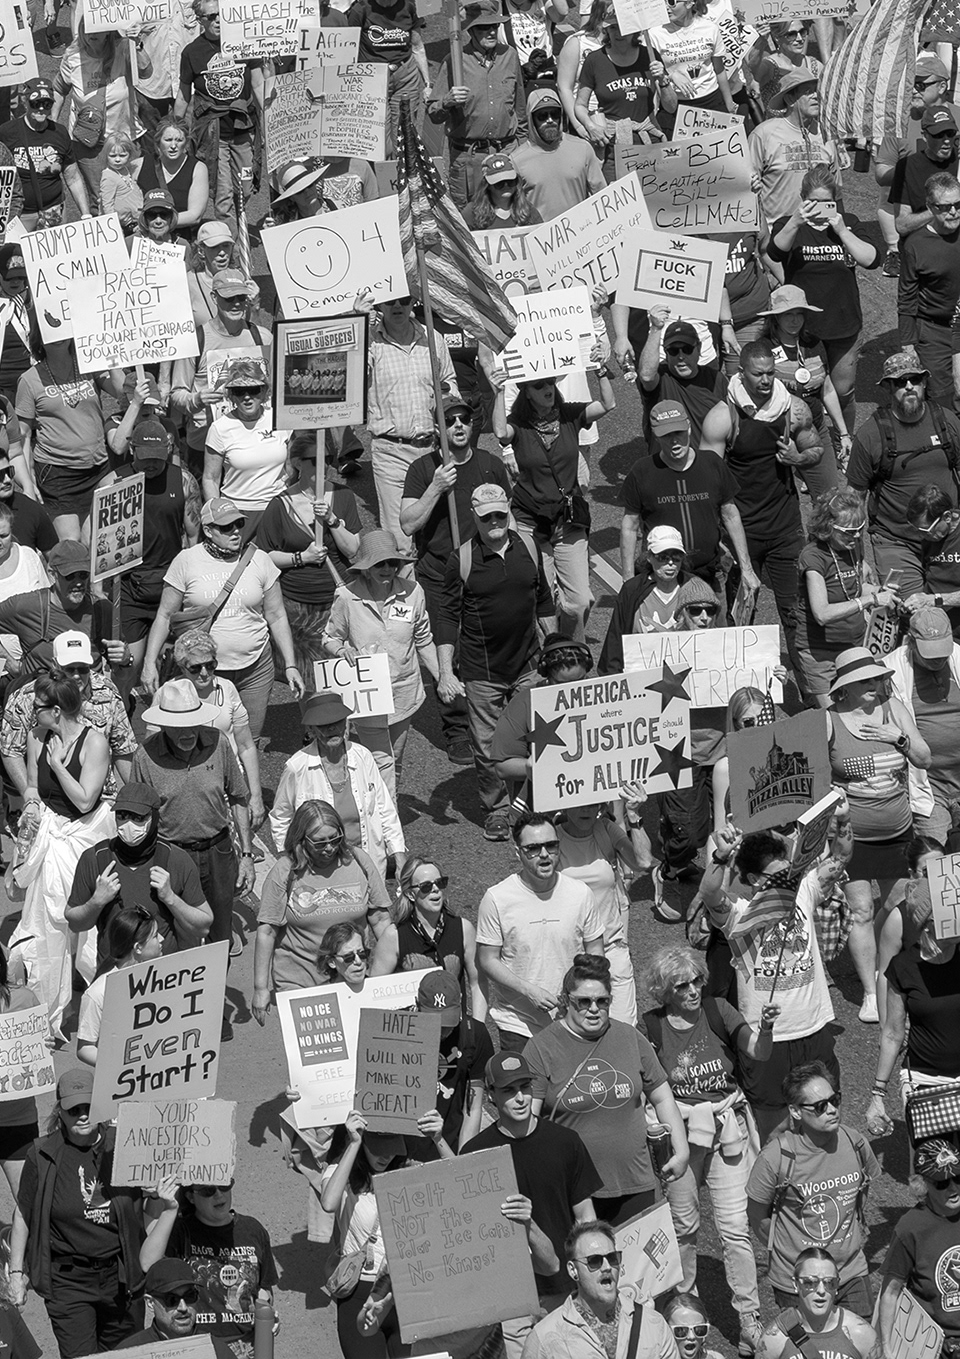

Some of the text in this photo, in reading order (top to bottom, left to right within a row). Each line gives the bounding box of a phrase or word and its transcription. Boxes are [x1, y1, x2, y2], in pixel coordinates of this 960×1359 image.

[655, 259, 697, 277] FUCK
[105, 267, 157, 293] RAGE
[660, 277, 686, 293] ICE
[97, 285, 168, 313] IS NOT
[104, 305, 160, 331] HATE
[99, 482, 143, 509] THE TURD
[657, 492, 710, 504] LOVE FOREVER
[98, 501, 142, 529] REICH
[555, 678, 647, 712] AMERICA...
[600, 709, 622, 719] where
[560, 715, 683, 761] JUSTICE should
[668, 729, 678, 739] be
[555, 757, 650, 798] for ALL!!!
[129, 965, 206, 1000] Where
[134, 989, 205, 1030] Do I
[299, 1003, 331, 1018] NO ICE
[299, 1016, 337, 1032] NO WAR
[383, 1012, 416, 1036] HATE
[123, 1027, 201, 1065] Even
[298, 1030, 343, 1047] NO KINGS
[366, 1050, 426, 1066] WILL NOT
[112, 1050, 216, 1101] Start?
[366, 1072, 421, 1088] MAKE US
[154, 1103, 197, 1123] YOUR
[361, 1092, 419, 1113] GREAT!
[123, 1125, 211, 1148] ANCESTORS
[152, 1146, 192, 1161] WERE
